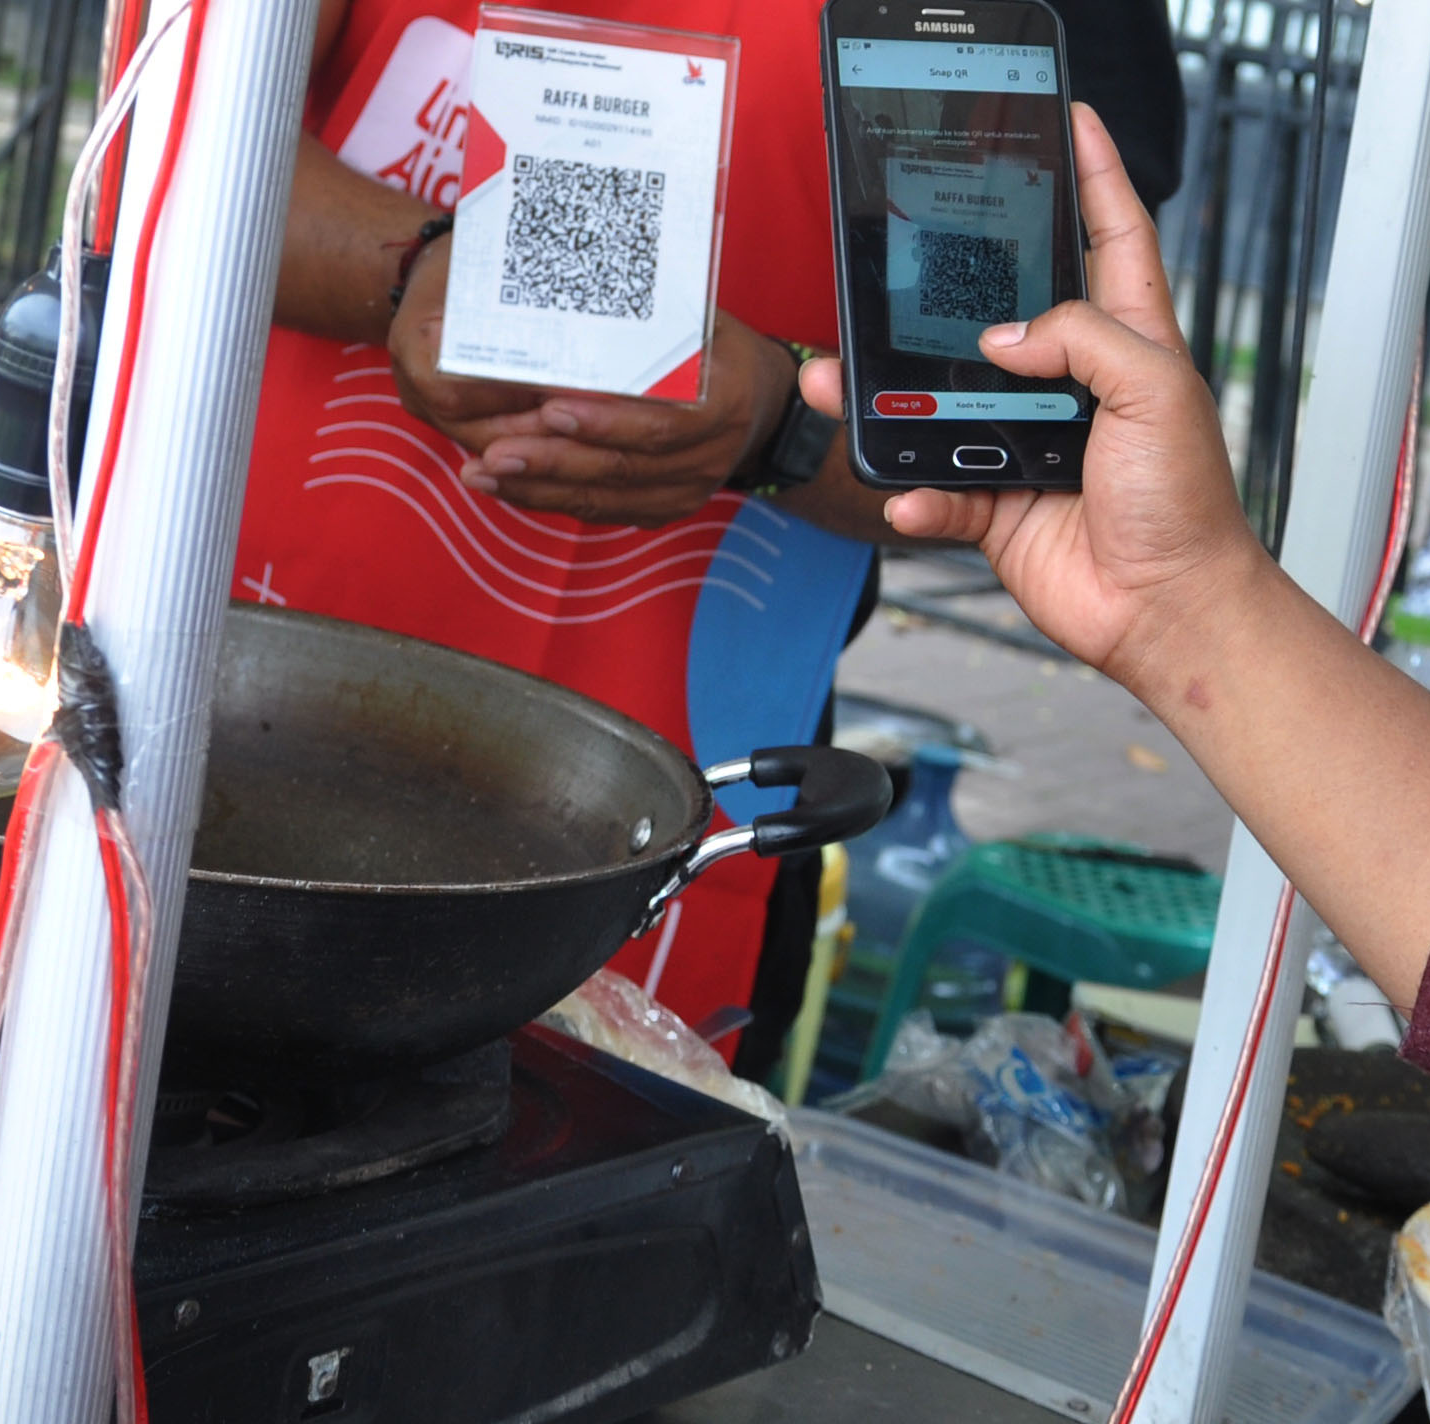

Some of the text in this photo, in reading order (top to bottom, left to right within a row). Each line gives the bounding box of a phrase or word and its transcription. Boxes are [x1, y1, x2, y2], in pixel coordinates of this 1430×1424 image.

[914, 21, 975, 34] SAMSUNG
[930, 68, 968, 78] Snap QR
[543, 88, 650, 117] RAFFA BURGER
[934, 191, 1005, 207] RAFFA BURGER
[891, 401, 908, 409] Snap
[956, 401, 973, 409] Kode
